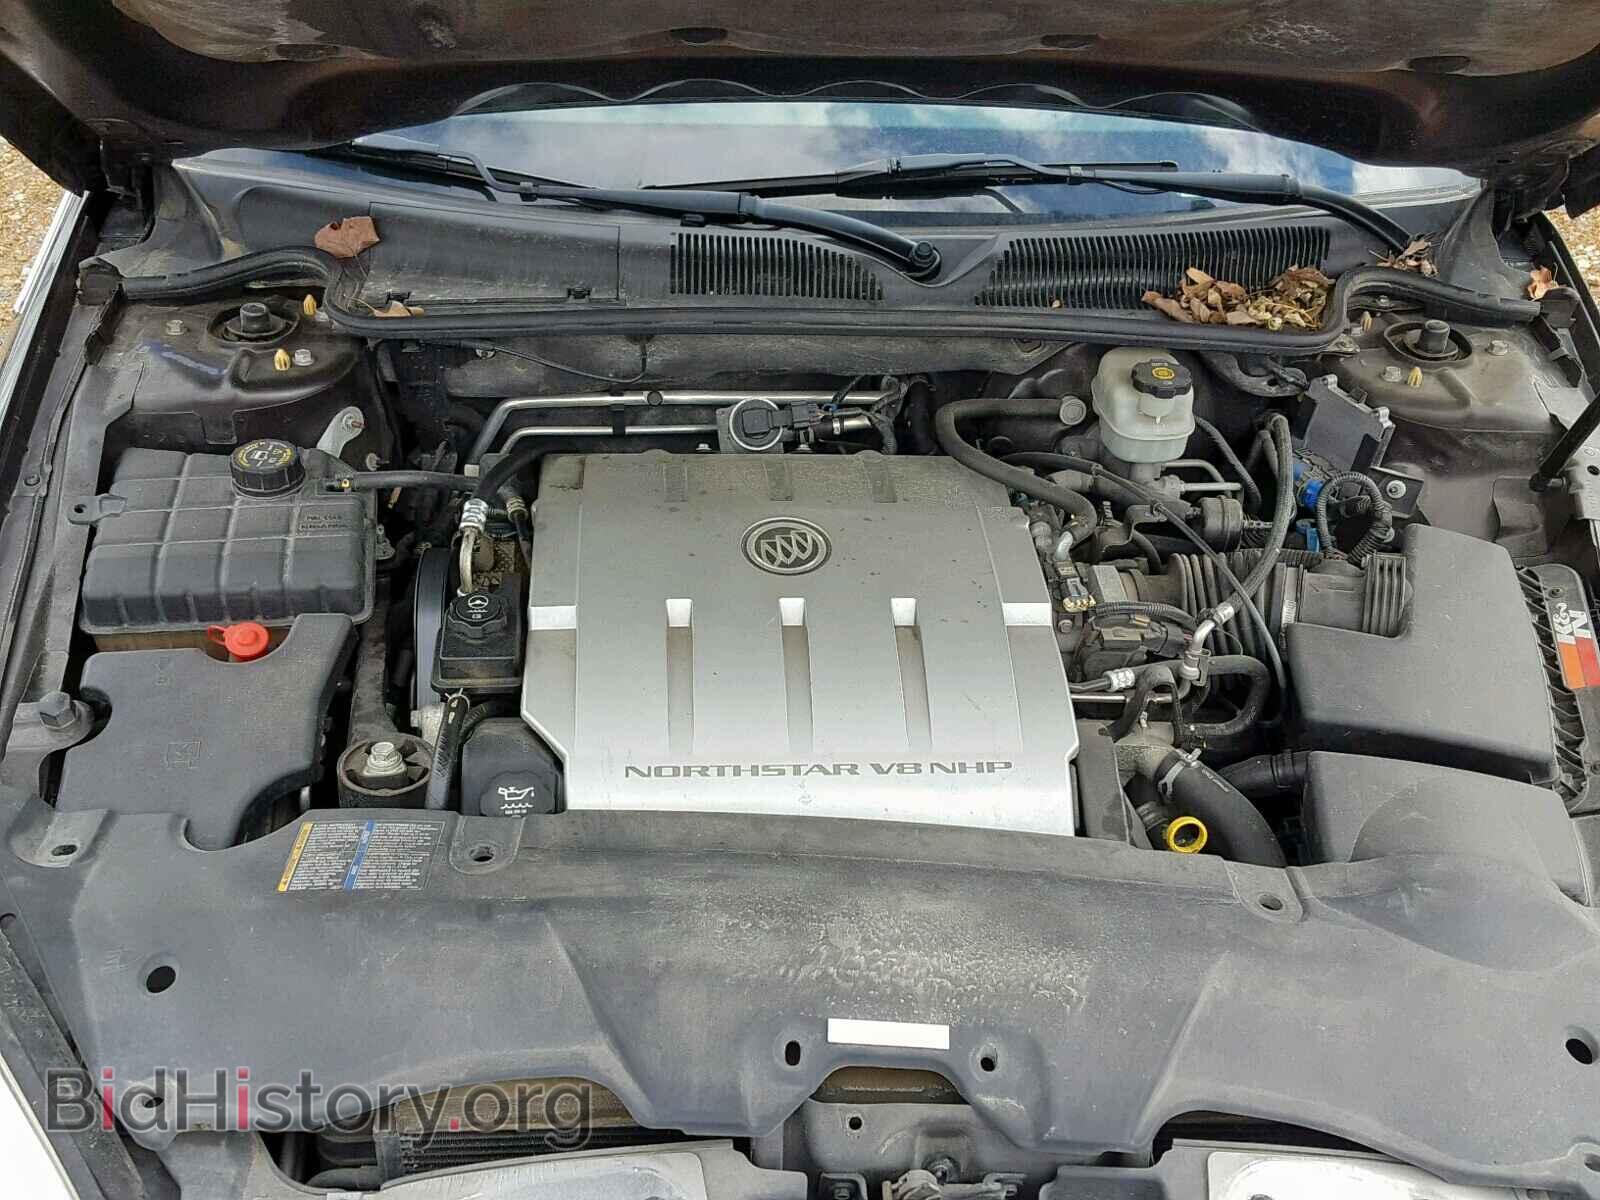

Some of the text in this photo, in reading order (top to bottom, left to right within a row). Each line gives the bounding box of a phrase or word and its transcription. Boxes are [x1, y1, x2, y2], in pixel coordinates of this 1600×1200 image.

[1553, 603, 1592, 645] K&N
[625, 762, 1013, 778] NORTHSTAR V8 NHP
